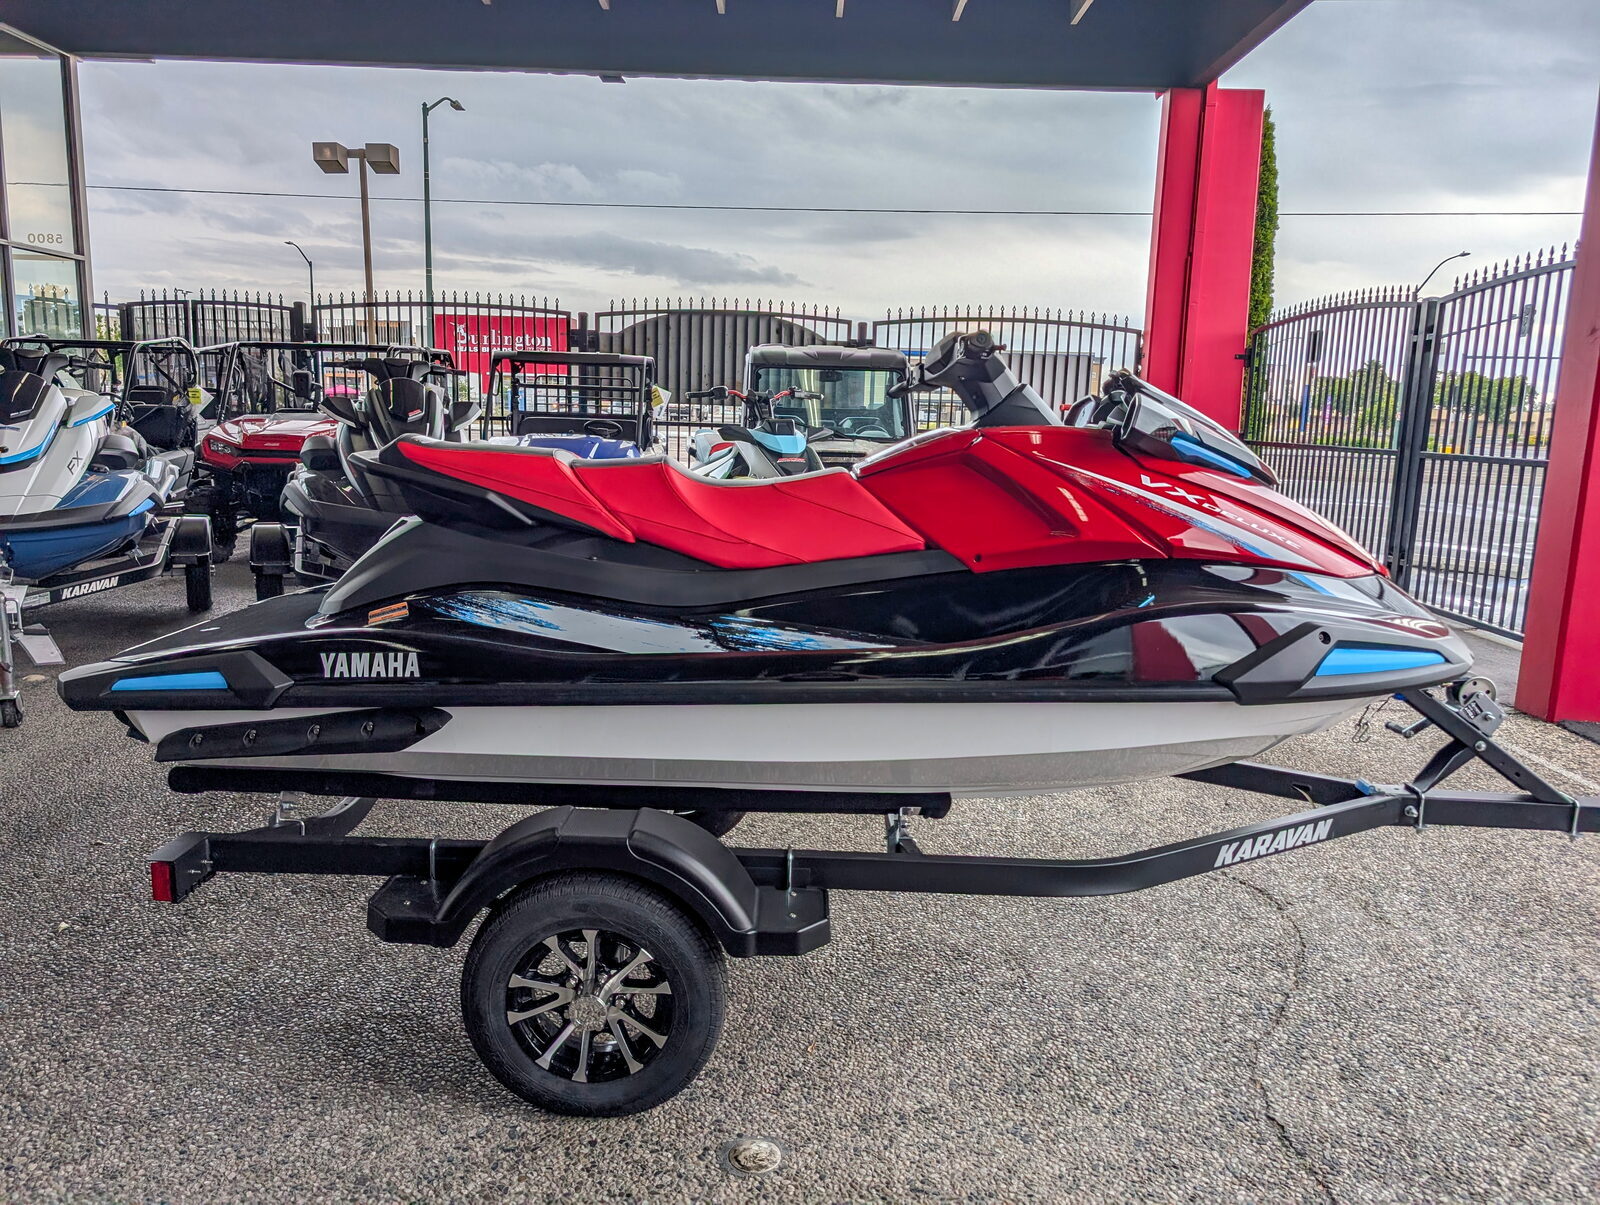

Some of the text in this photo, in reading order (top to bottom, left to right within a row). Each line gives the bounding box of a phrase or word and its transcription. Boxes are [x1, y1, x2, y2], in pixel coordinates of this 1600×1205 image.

[454, 329, 552, 351] Burlington
[67, 450, 83, 475] FX
[1140, 474, 1302, 550] VX DELUXE
[61, 576, 119, 600] KARAVAN
[320, 652, 420, 677] YAMAHA
[1213, 818, 1334, 868] KARAVAN
